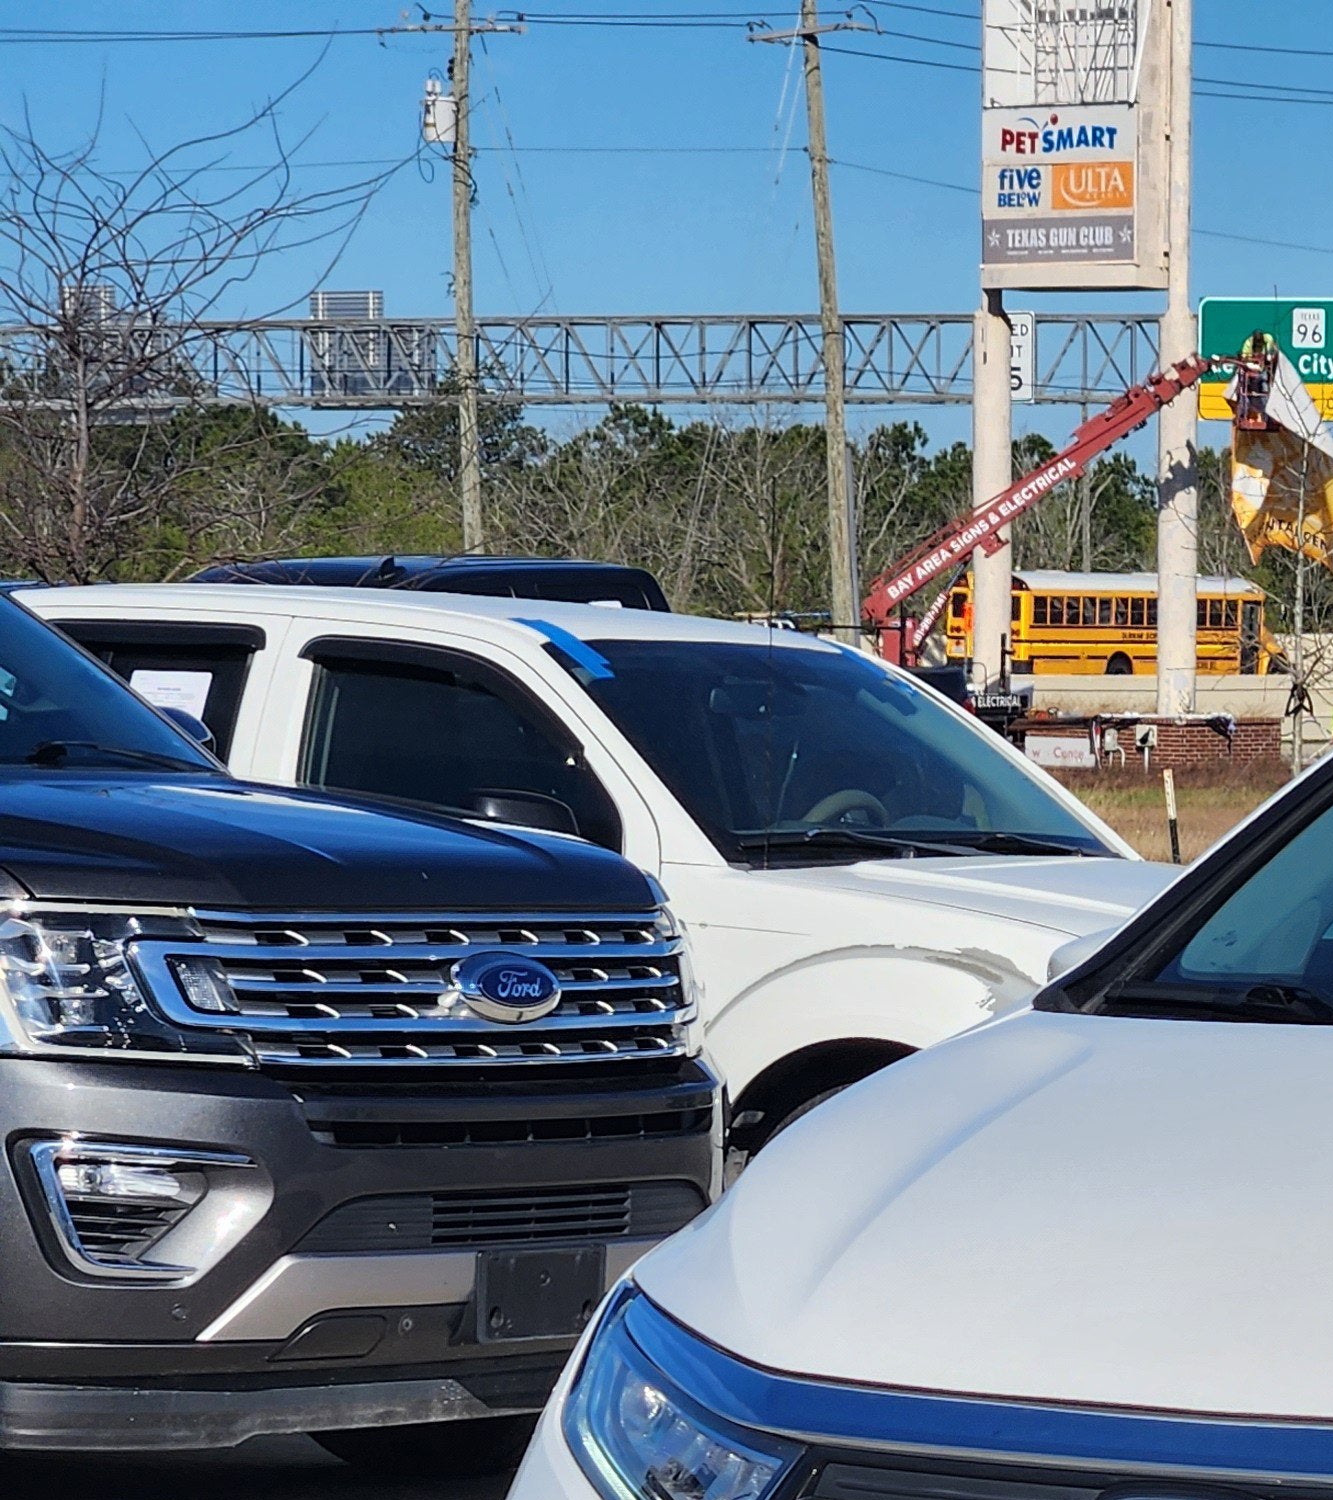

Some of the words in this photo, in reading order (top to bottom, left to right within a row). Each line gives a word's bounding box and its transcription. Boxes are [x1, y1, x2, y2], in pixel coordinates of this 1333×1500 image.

[998, 167, 1042, 191] five
[1069, 167, 1125, 193] ULTA
[997, 192, 1041, 208] BELOW
[1006, 228, 1047, 248] TEXAS
[1049, 226, 1077, 247] GUN
[1079, 225, 1114, 247] CLUB
[1297, 323, 1322, 344] 96
[1010, 366, 1023, 391] 5
[887, 573, 915, 599] BAY
[915, 548, 952, 580] AREA
[950, 519, 989, 552] SIGNS
[998, 458, 1077, 517] ELECTRICAL
[977, 693, 1022, 708] ELECTRICAL
[497, 970, 542, 998] Ford
